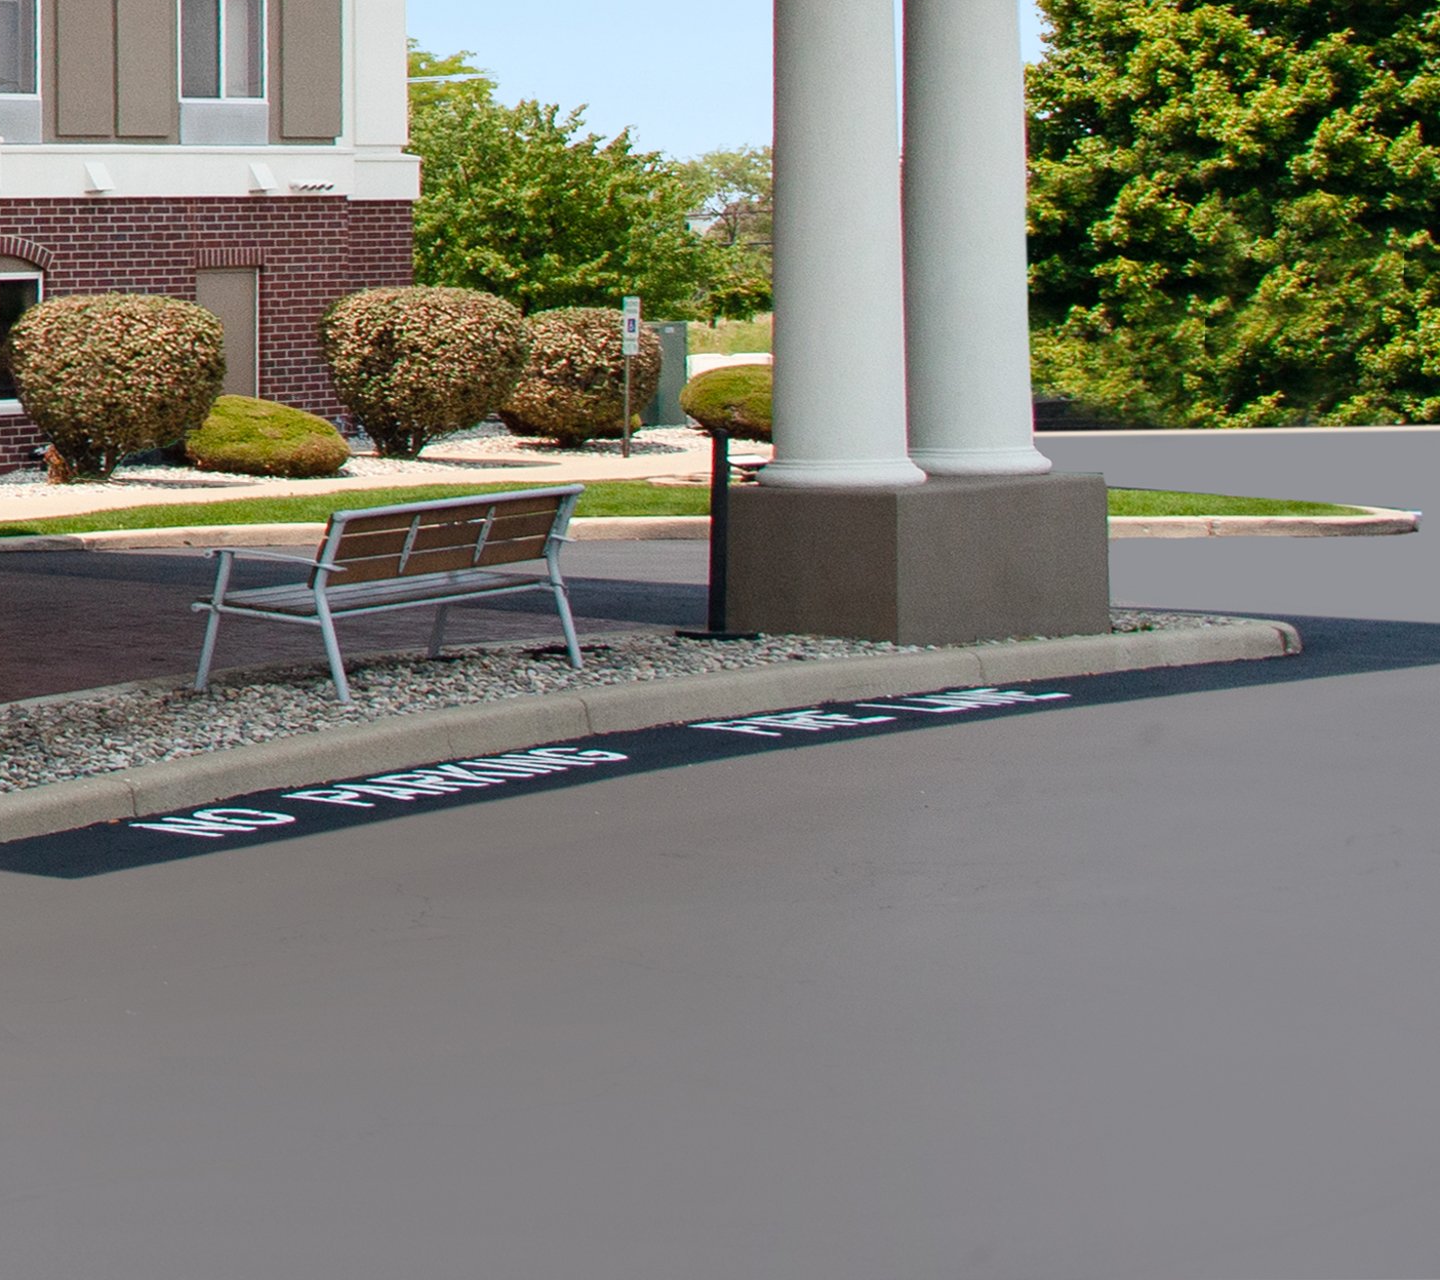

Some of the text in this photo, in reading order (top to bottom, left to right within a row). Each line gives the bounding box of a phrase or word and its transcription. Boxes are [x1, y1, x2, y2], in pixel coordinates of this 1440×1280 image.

[129, 687, 1072, 837] NO PARKING FIRE LANE
